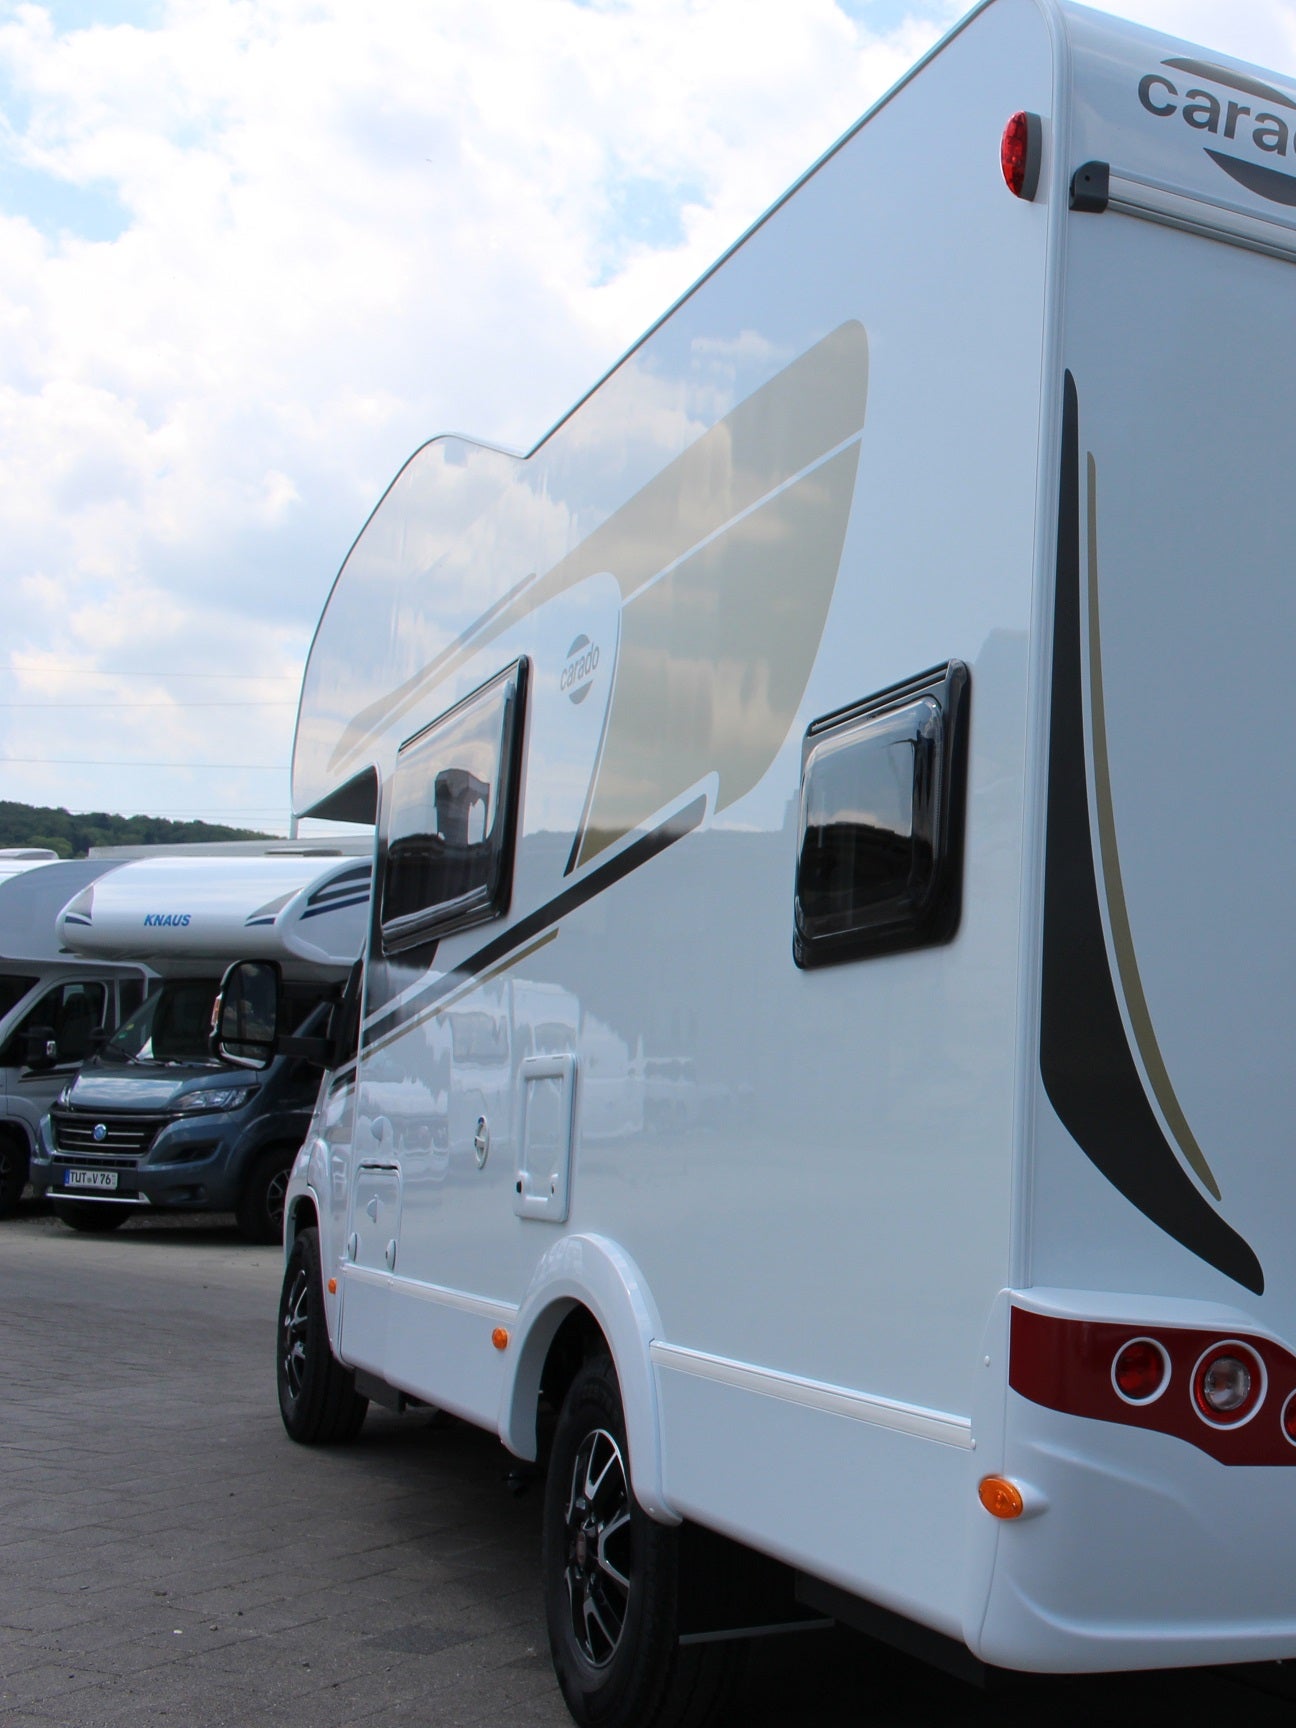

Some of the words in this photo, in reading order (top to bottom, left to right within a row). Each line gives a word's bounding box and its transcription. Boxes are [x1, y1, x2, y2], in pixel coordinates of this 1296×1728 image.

[561, 642, 600, 691] carado
[143, 914, 192, 926] KNAUS
[71, 1171, 87, 1184] TUT
